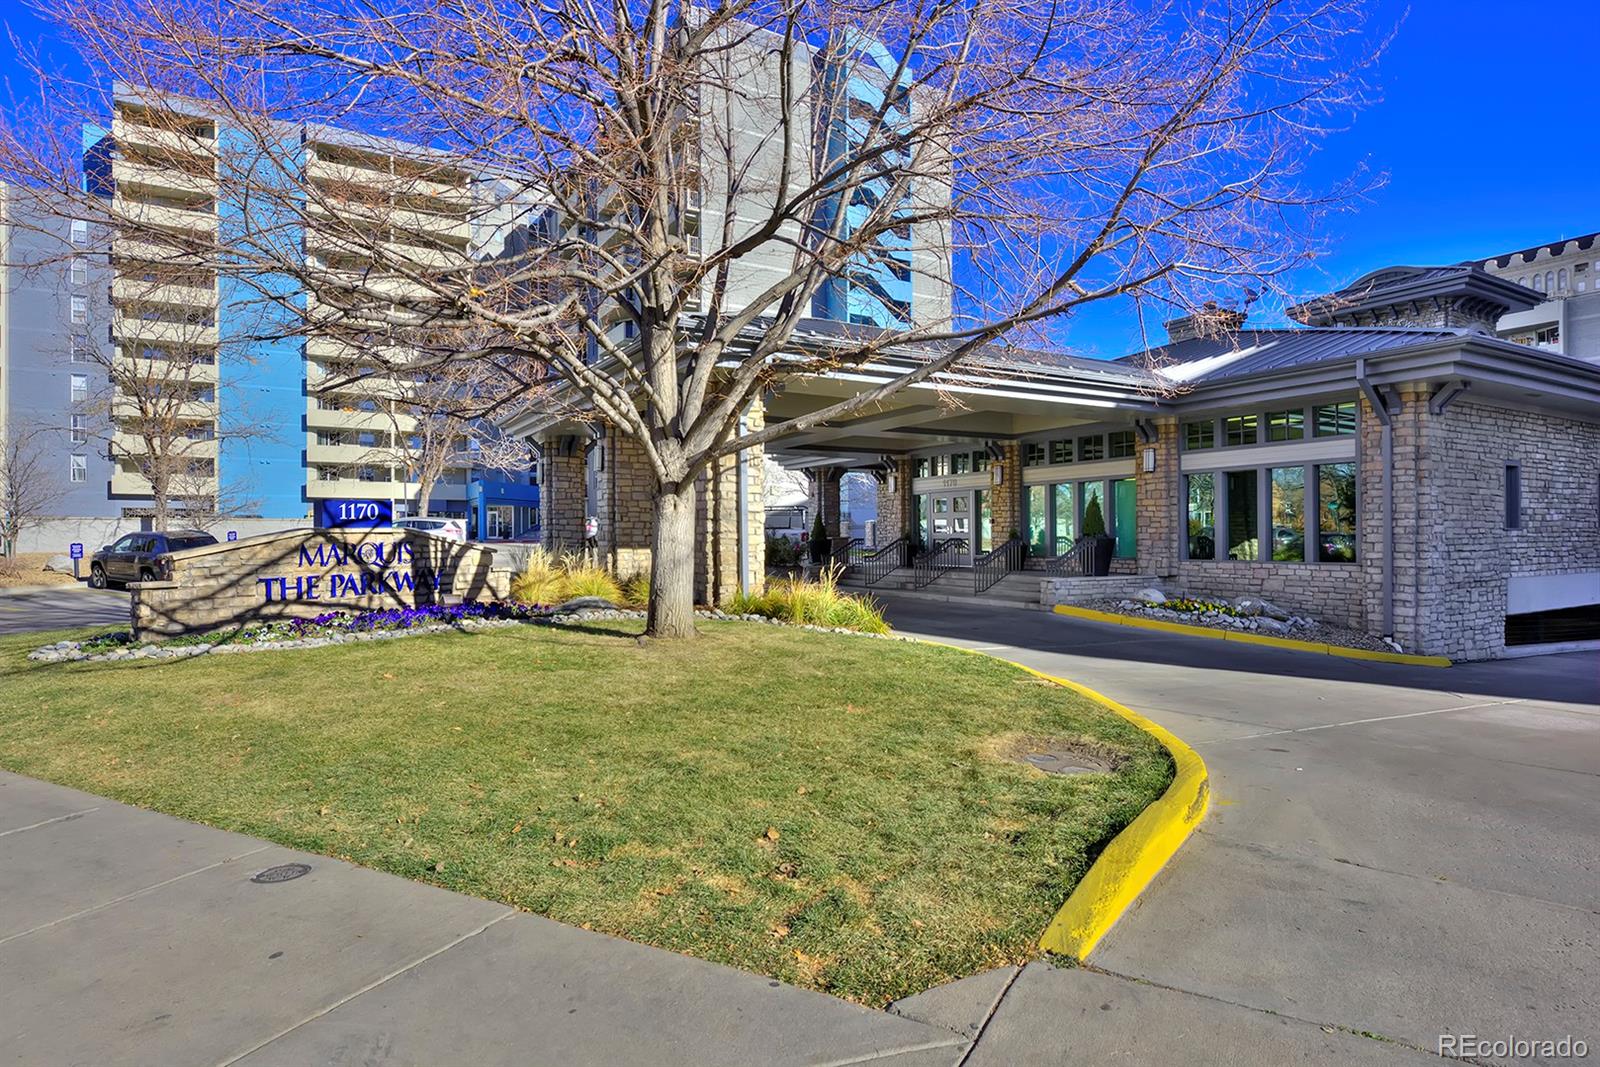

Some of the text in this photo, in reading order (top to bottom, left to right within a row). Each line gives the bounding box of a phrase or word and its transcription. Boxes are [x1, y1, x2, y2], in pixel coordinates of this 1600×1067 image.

[339, 503, 379, 520] 1170
[298, 541, 415, 568] MARQUIS
[255, 568, 444, 602] THE PARKWAY
